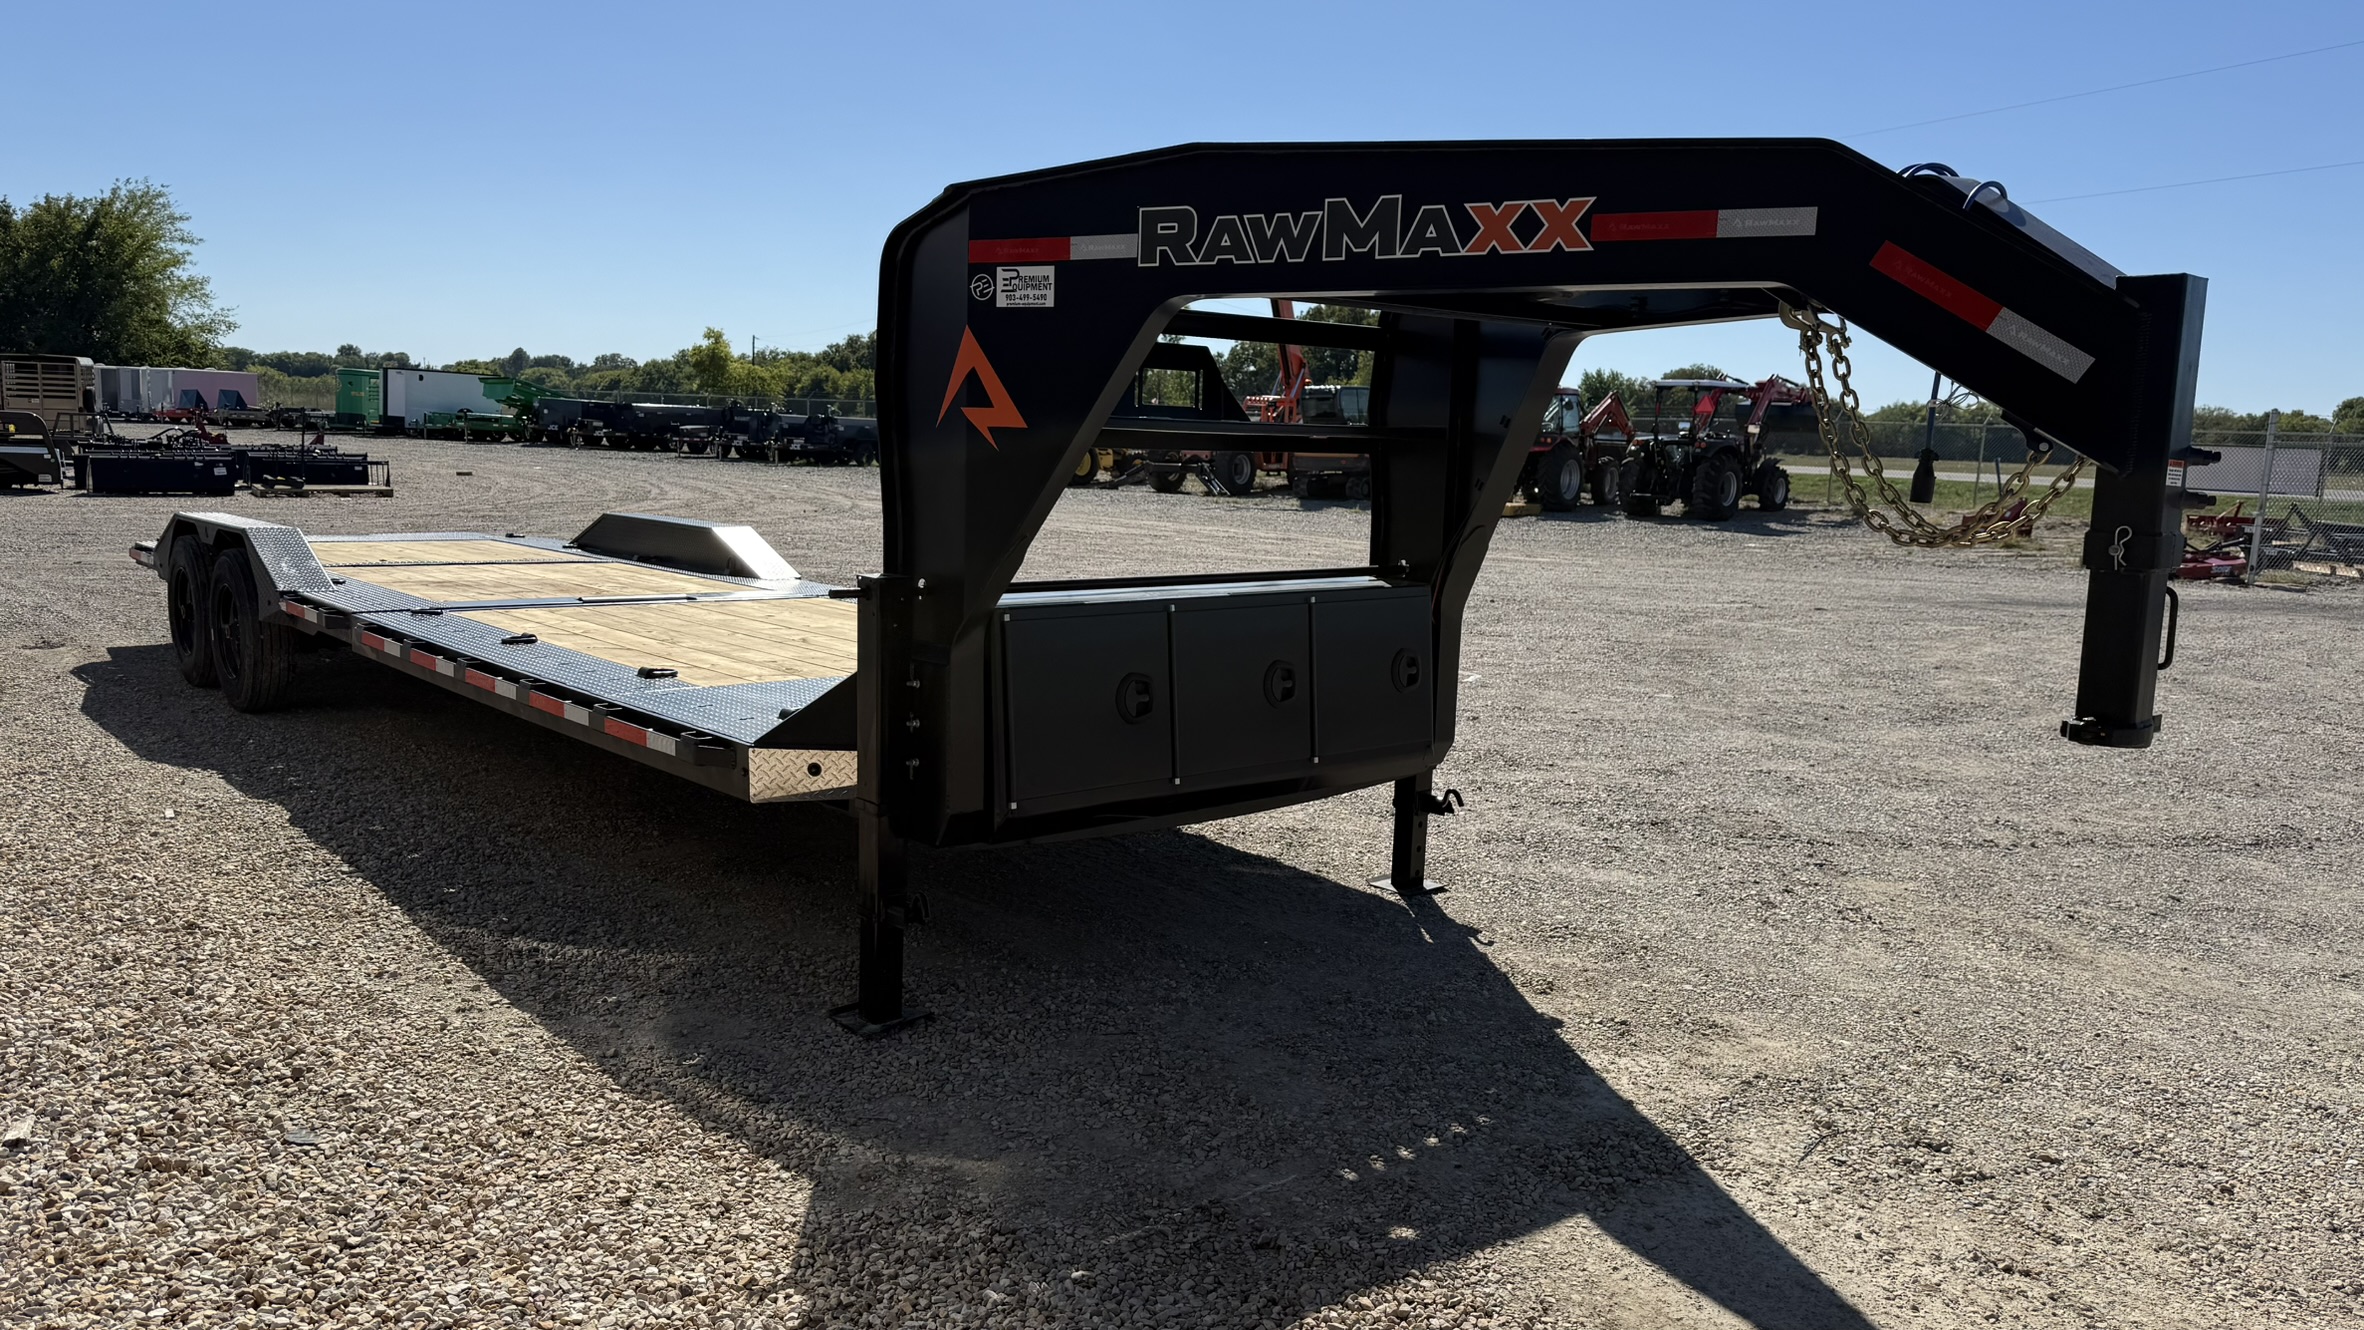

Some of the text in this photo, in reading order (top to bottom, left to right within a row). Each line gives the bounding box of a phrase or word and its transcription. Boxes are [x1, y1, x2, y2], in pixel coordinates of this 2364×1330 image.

[1138, 194, 1597, 267] RAWMAXX
[1002, 268, 1050, 285] PREMIUM
[1001, 278, 1053, 292] EQUIPMENT
[1005, 293, 1047, 301] 903-499-5490
